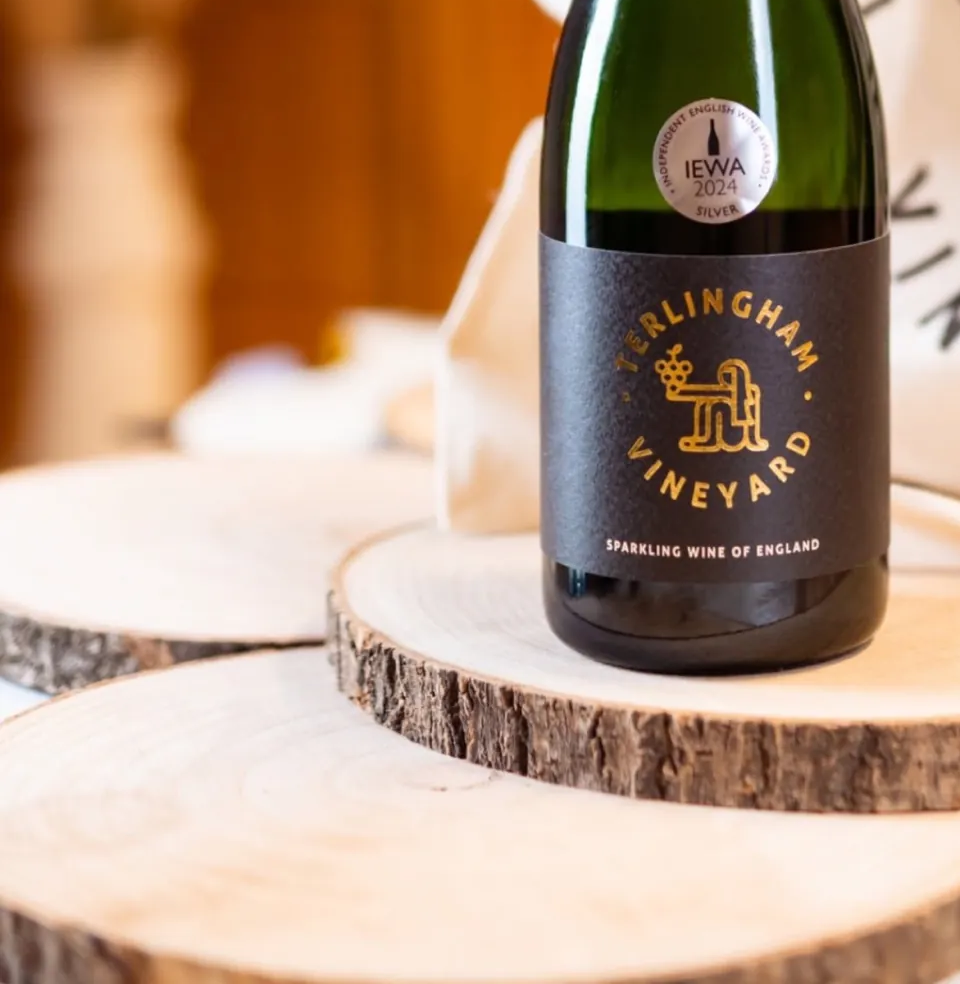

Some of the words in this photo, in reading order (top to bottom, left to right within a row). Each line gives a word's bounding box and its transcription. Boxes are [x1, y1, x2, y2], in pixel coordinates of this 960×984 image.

[658, 113, 687, 188] INDEPENDENT
[688, 104, 735, 117] ENGLISH
[685, 157, 746, 179] IEWA
[693, 178, 738, 197] 2024
[695, 204, 739, 218] SILVER
[615, 288, 819, 373] TERLINGHAM
[627, 431, 811, 509] VINEYARD
[606, 538, 682, 558] SPARKLING
[687, 545, 726, 559] WINE
[731, 545, 751, 558] OF
[756, 538, 820, 557] ENGLAND
